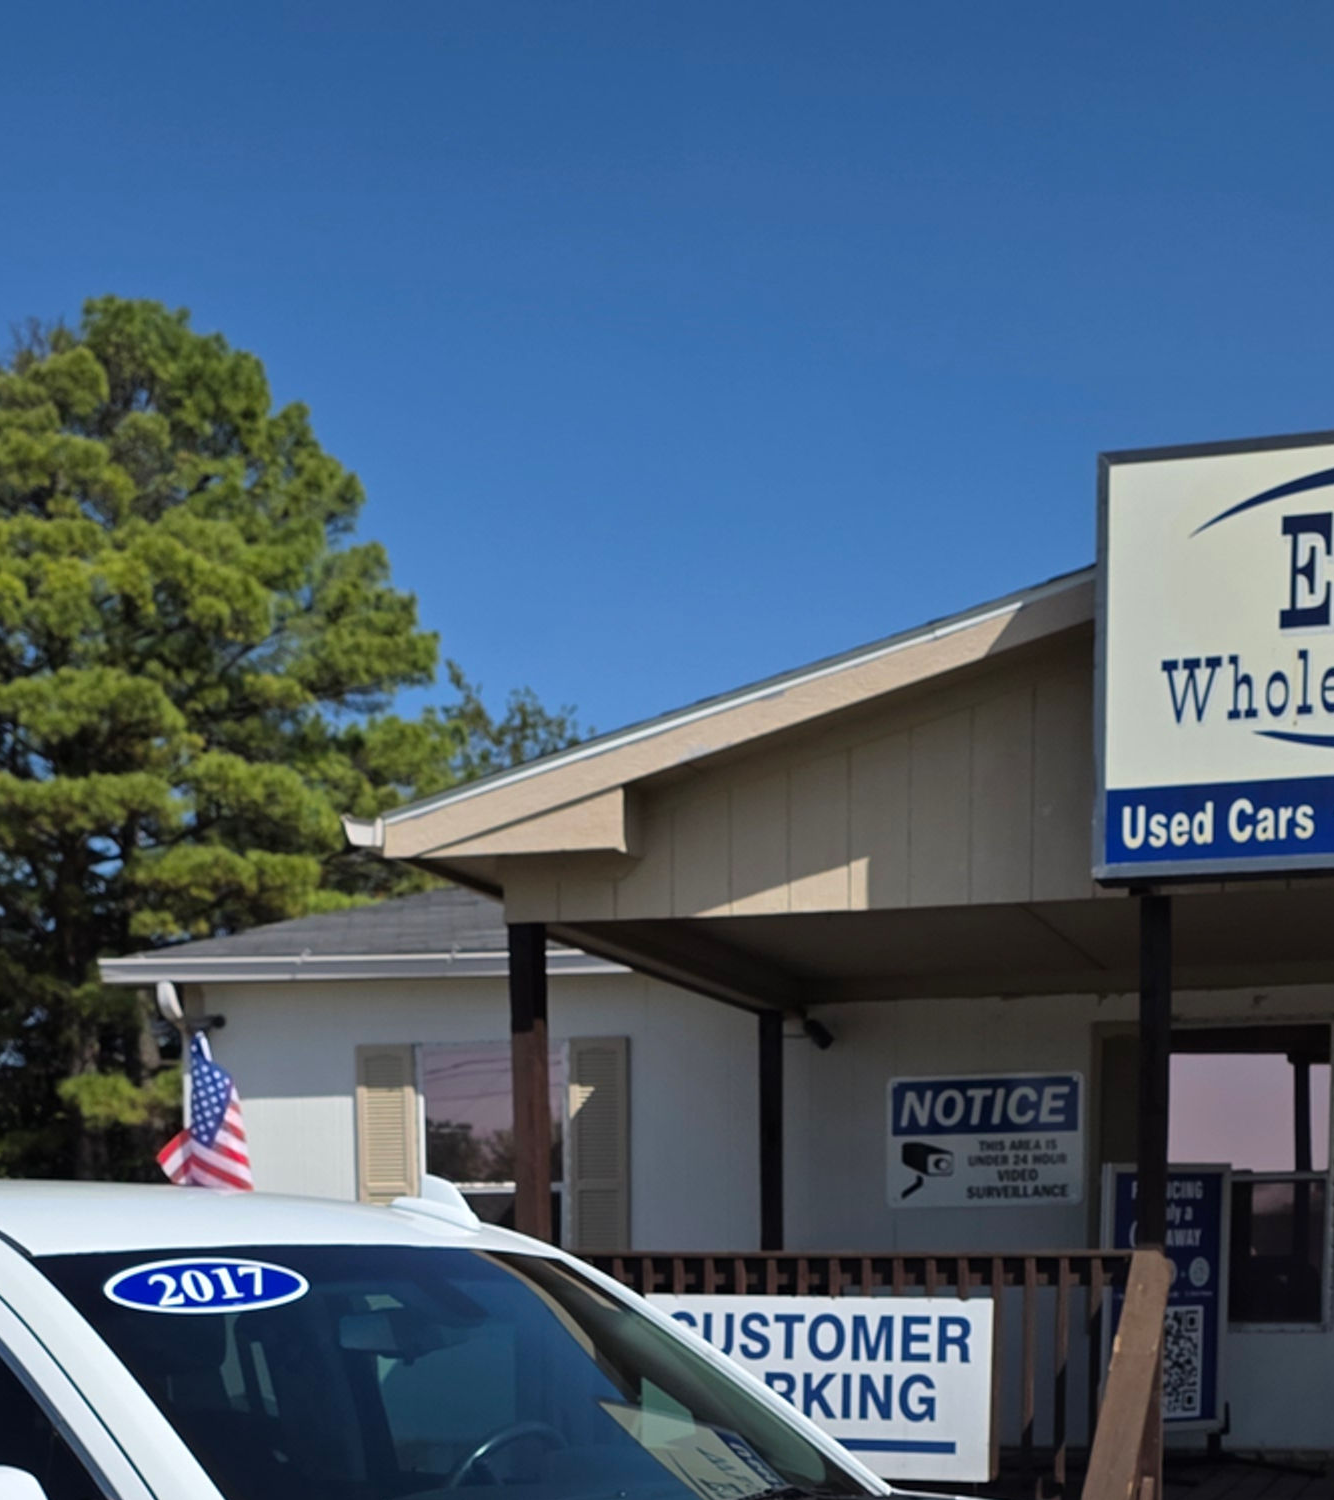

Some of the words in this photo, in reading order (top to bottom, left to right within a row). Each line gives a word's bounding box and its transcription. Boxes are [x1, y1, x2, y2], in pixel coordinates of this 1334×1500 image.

[1122, 801, 1213, 849] Used
[1228, 797, 1315, 842] Cars
[900, 1085, 1070, 1128] NOTICE
[978, 1140, 1006, 1152] THIS
[1009, 1139, 1042, 1152] AREA
[1045, 1139, 1058, 1150] IS
[968, 1154, 1010, 1167] UNDER
[1013, 1154, 1029, 1166] 24
[1032, 1153, 1067, 1165] HOUR
[997, 1169, 1039, 1182] VIDEO
[966, 1184, 1069, 1199] SURVEILLANCE
[147, 1266, 263, 1307] 2017
[764, 1371, 937, 1422] RKING
